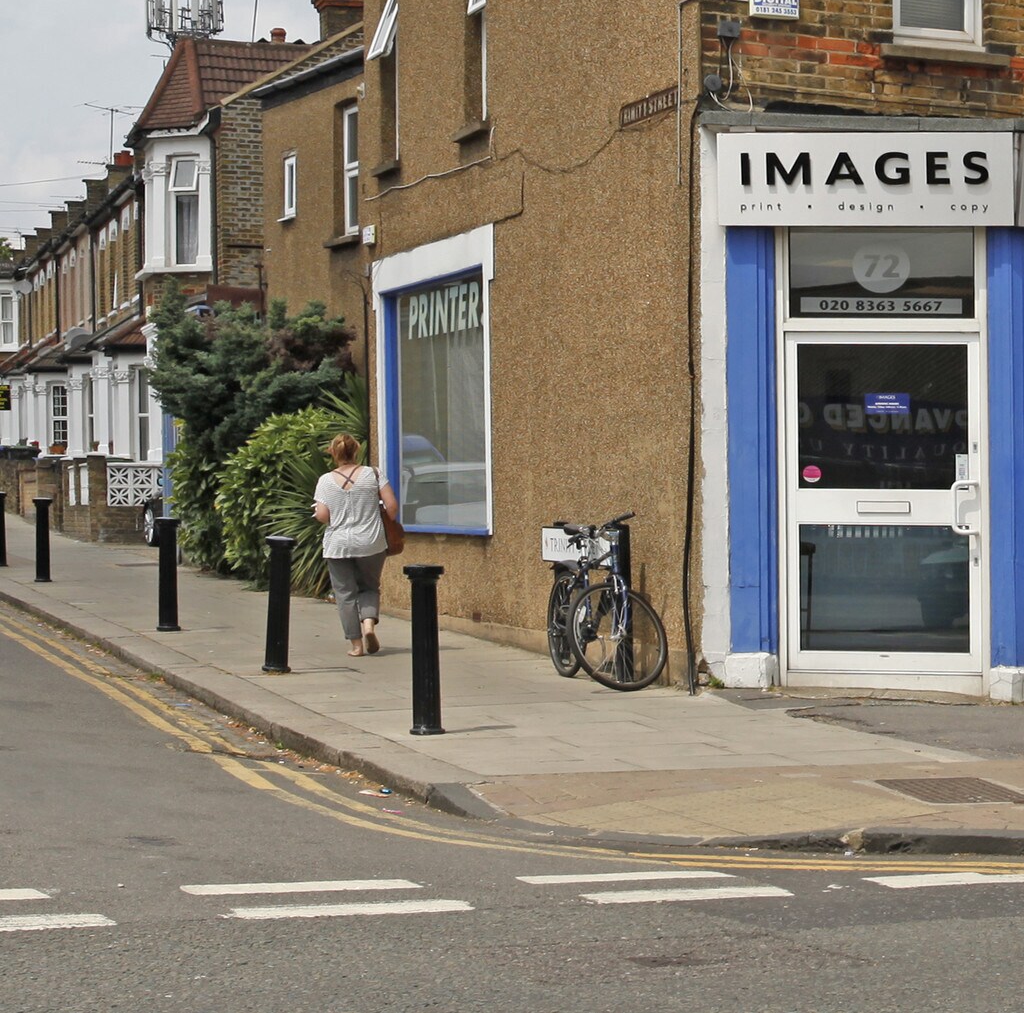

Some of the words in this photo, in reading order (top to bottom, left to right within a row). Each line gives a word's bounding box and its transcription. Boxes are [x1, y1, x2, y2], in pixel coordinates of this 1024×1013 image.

[740, 152, 990, 186] IMAGES
[740, 202, 783, 214] print
[838, 201, 895, 214] design
[950, 203, 990, 214] copy
[863, 254, 900, 278] 72
[408, 281, 484, 340] PRINTER
[819, 300, 849, 311] 020
[855, 300, 896, 311] 8363
[902, 300, 943, 312] 5667
